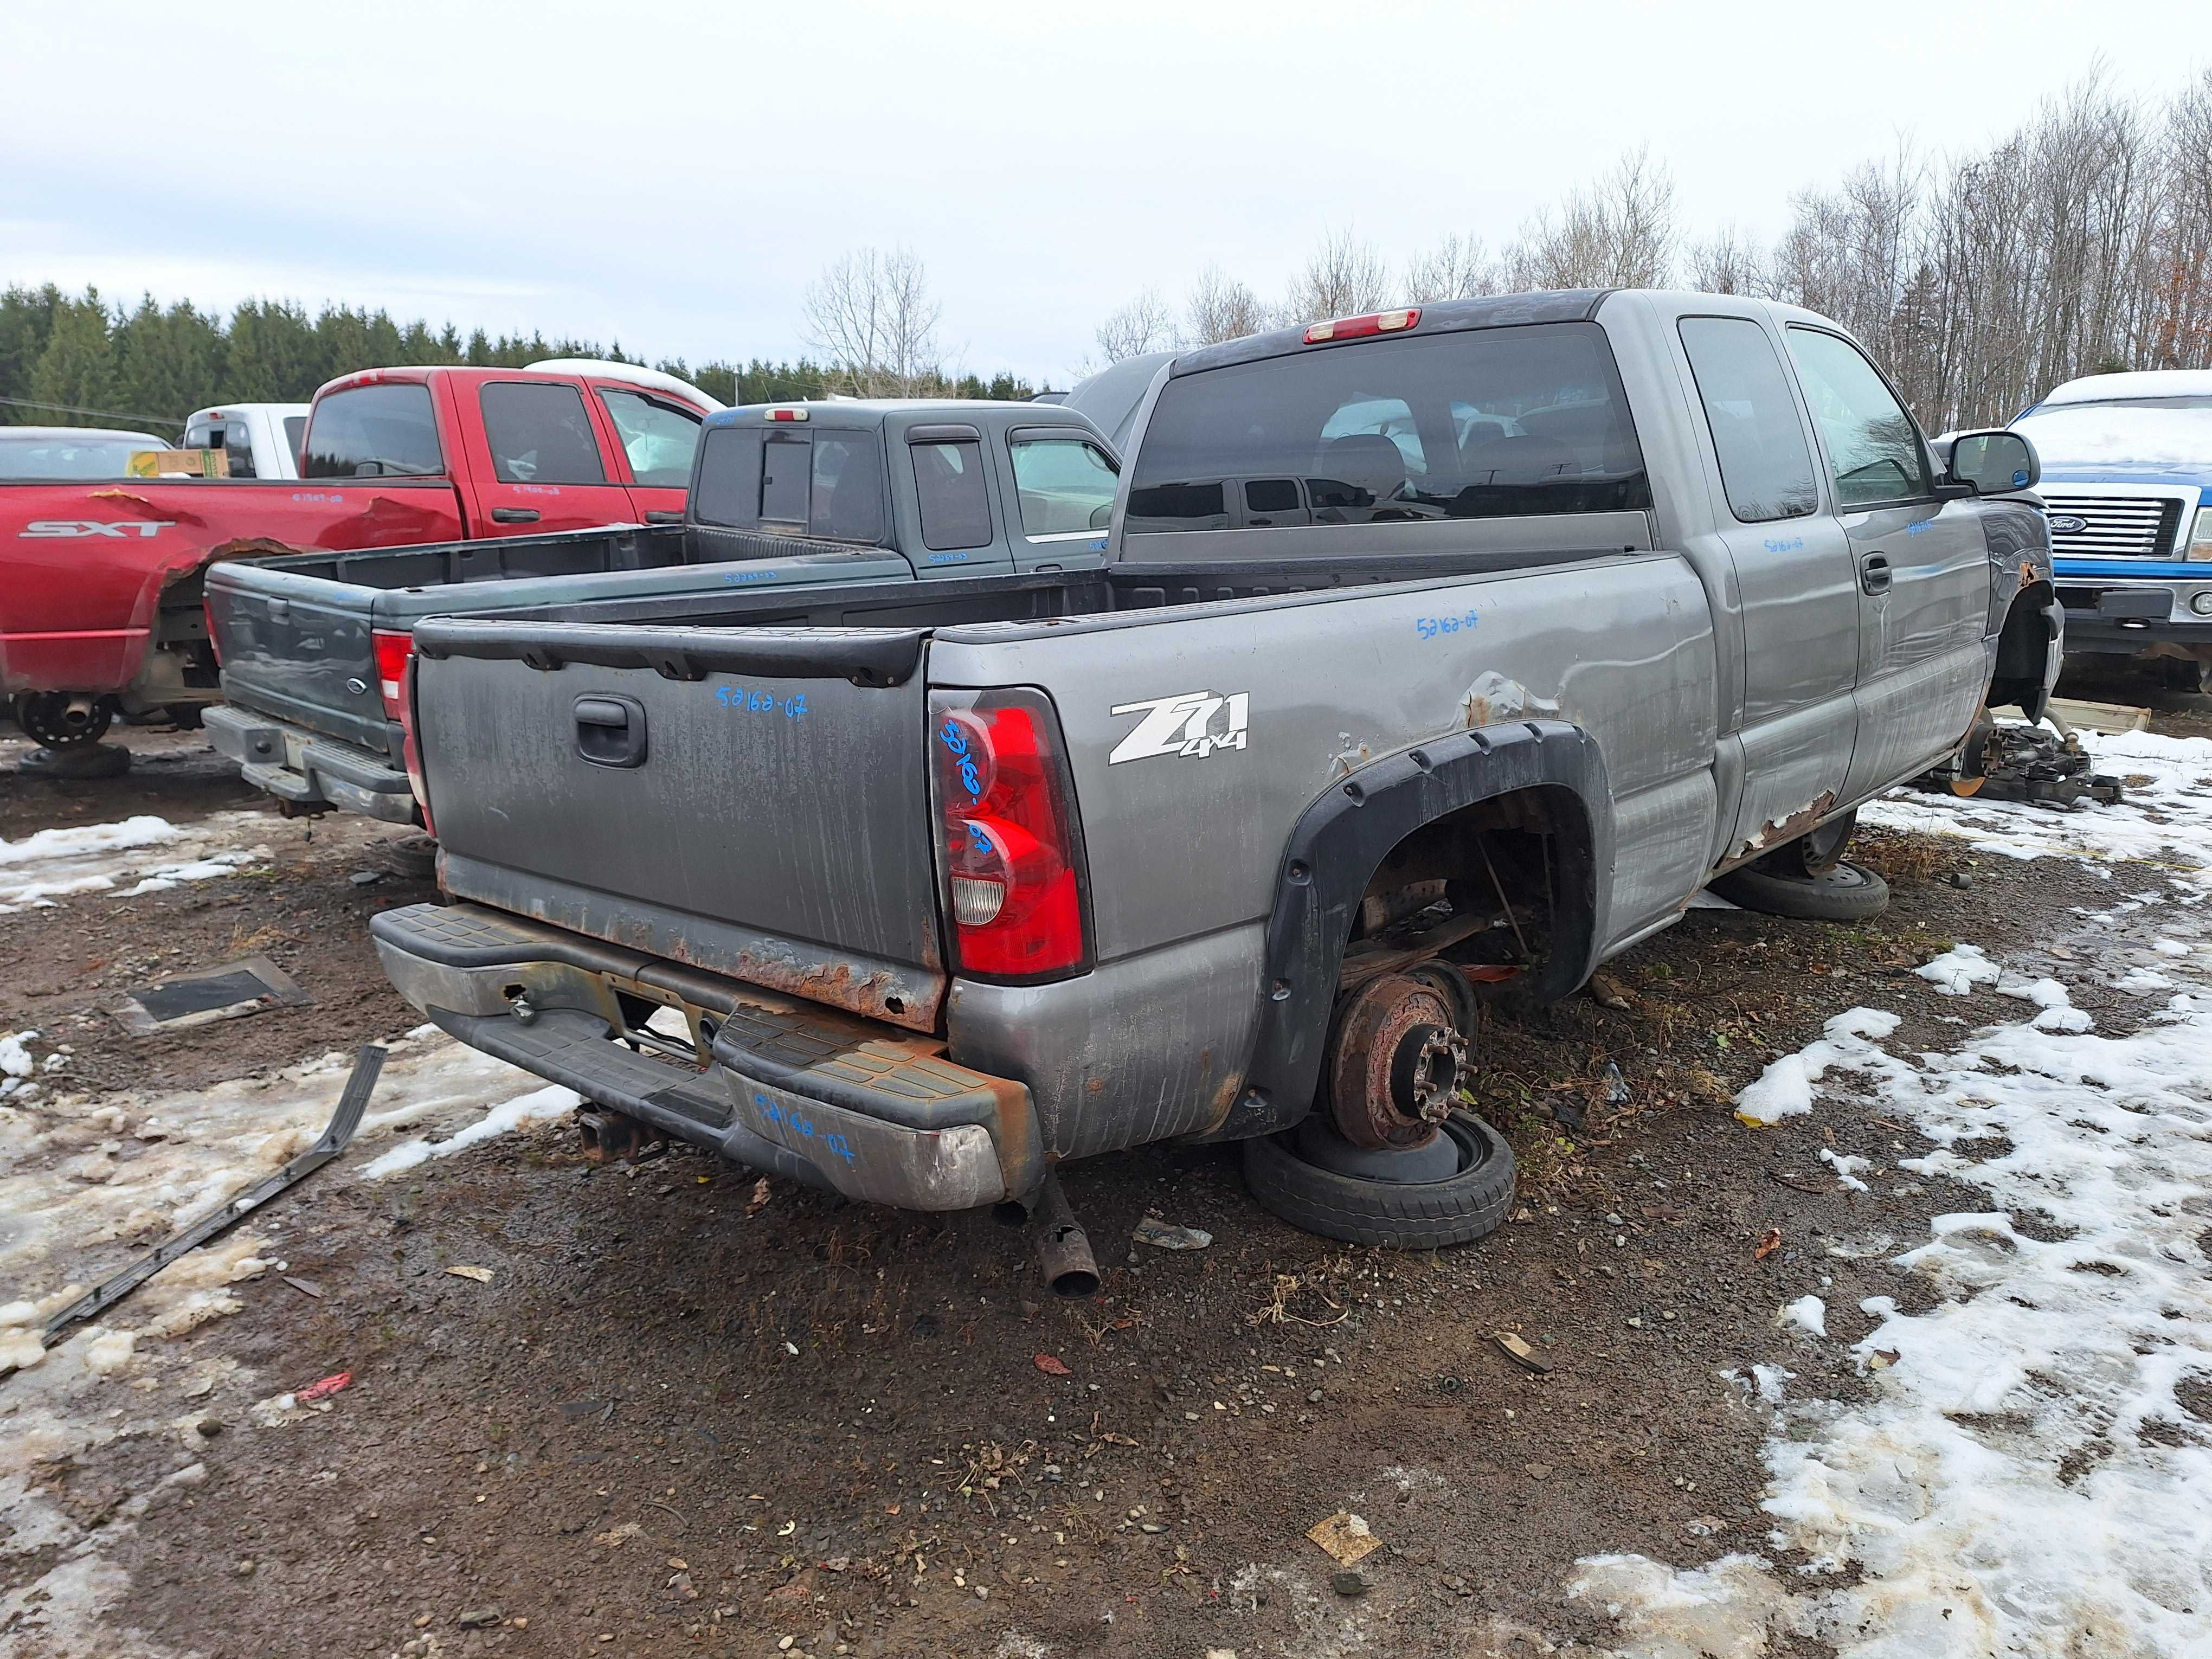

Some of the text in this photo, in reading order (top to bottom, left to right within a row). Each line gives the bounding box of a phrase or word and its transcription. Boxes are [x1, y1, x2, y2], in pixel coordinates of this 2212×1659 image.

[18, 521, 176, 538] SXT
[2050, 519, 2075, 528] Ford
[716, 686, 808, 723] 52162-07
[1108, 689, 1250, 767] Z71
